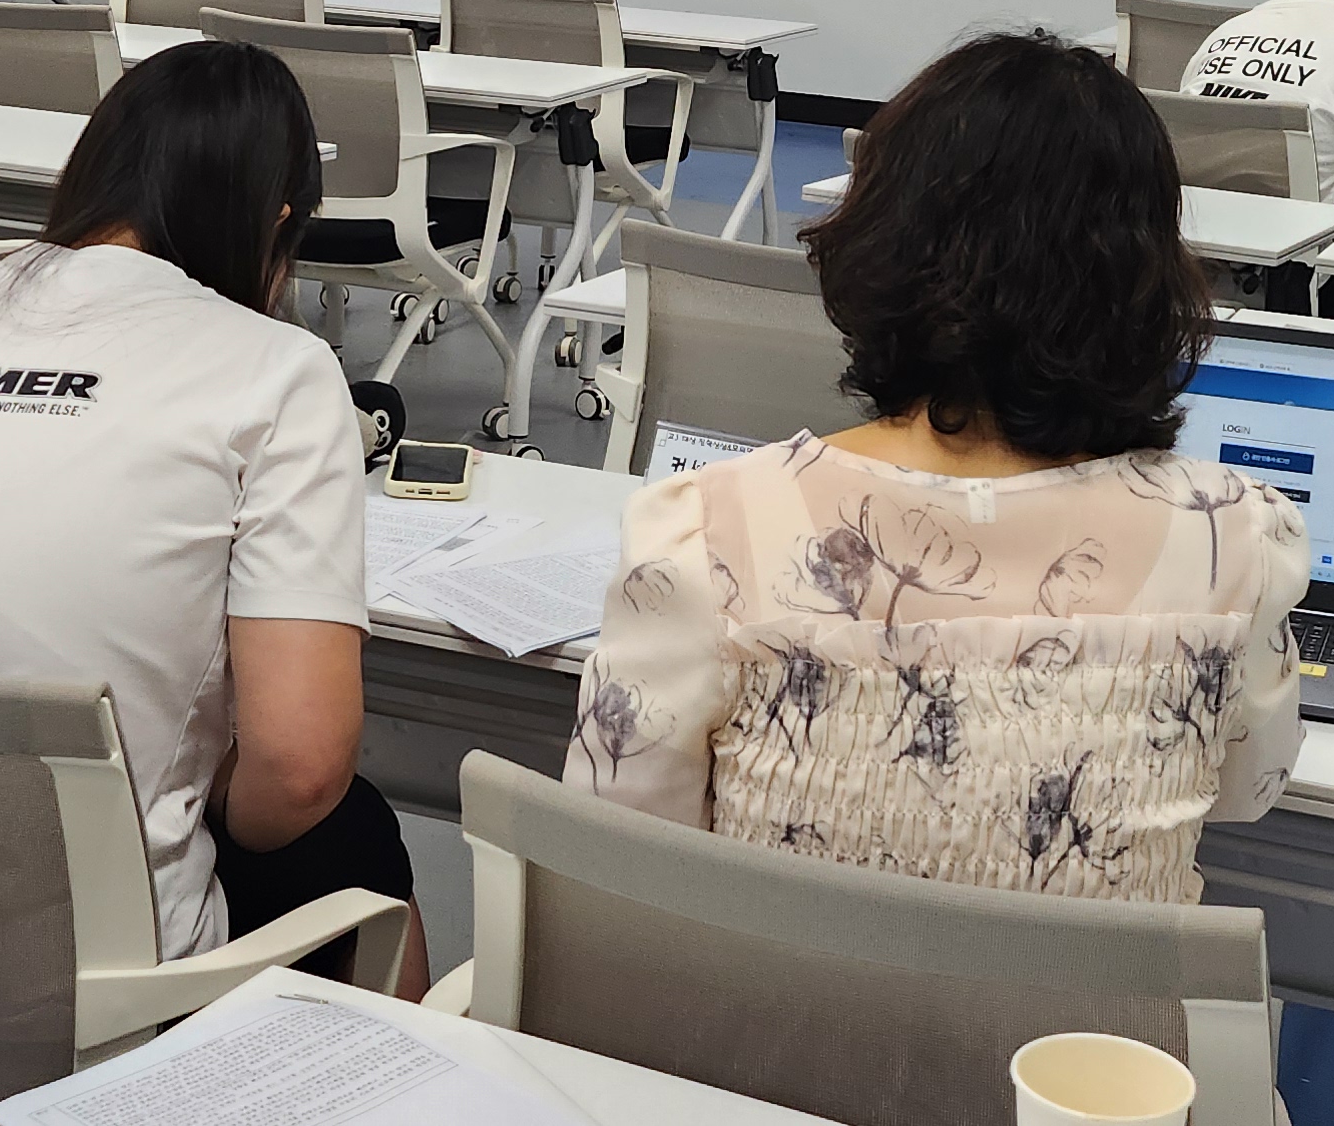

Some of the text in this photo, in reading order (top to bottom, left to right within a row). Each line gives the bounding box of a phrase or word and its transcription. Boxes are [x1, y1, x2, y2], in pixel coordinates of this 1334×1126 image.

[1208, 35, 1318, 60] OFFICIAL
[1241, 58, 1317, 87] ONLY
[1222, 423, 1251, 436] LOGIN
